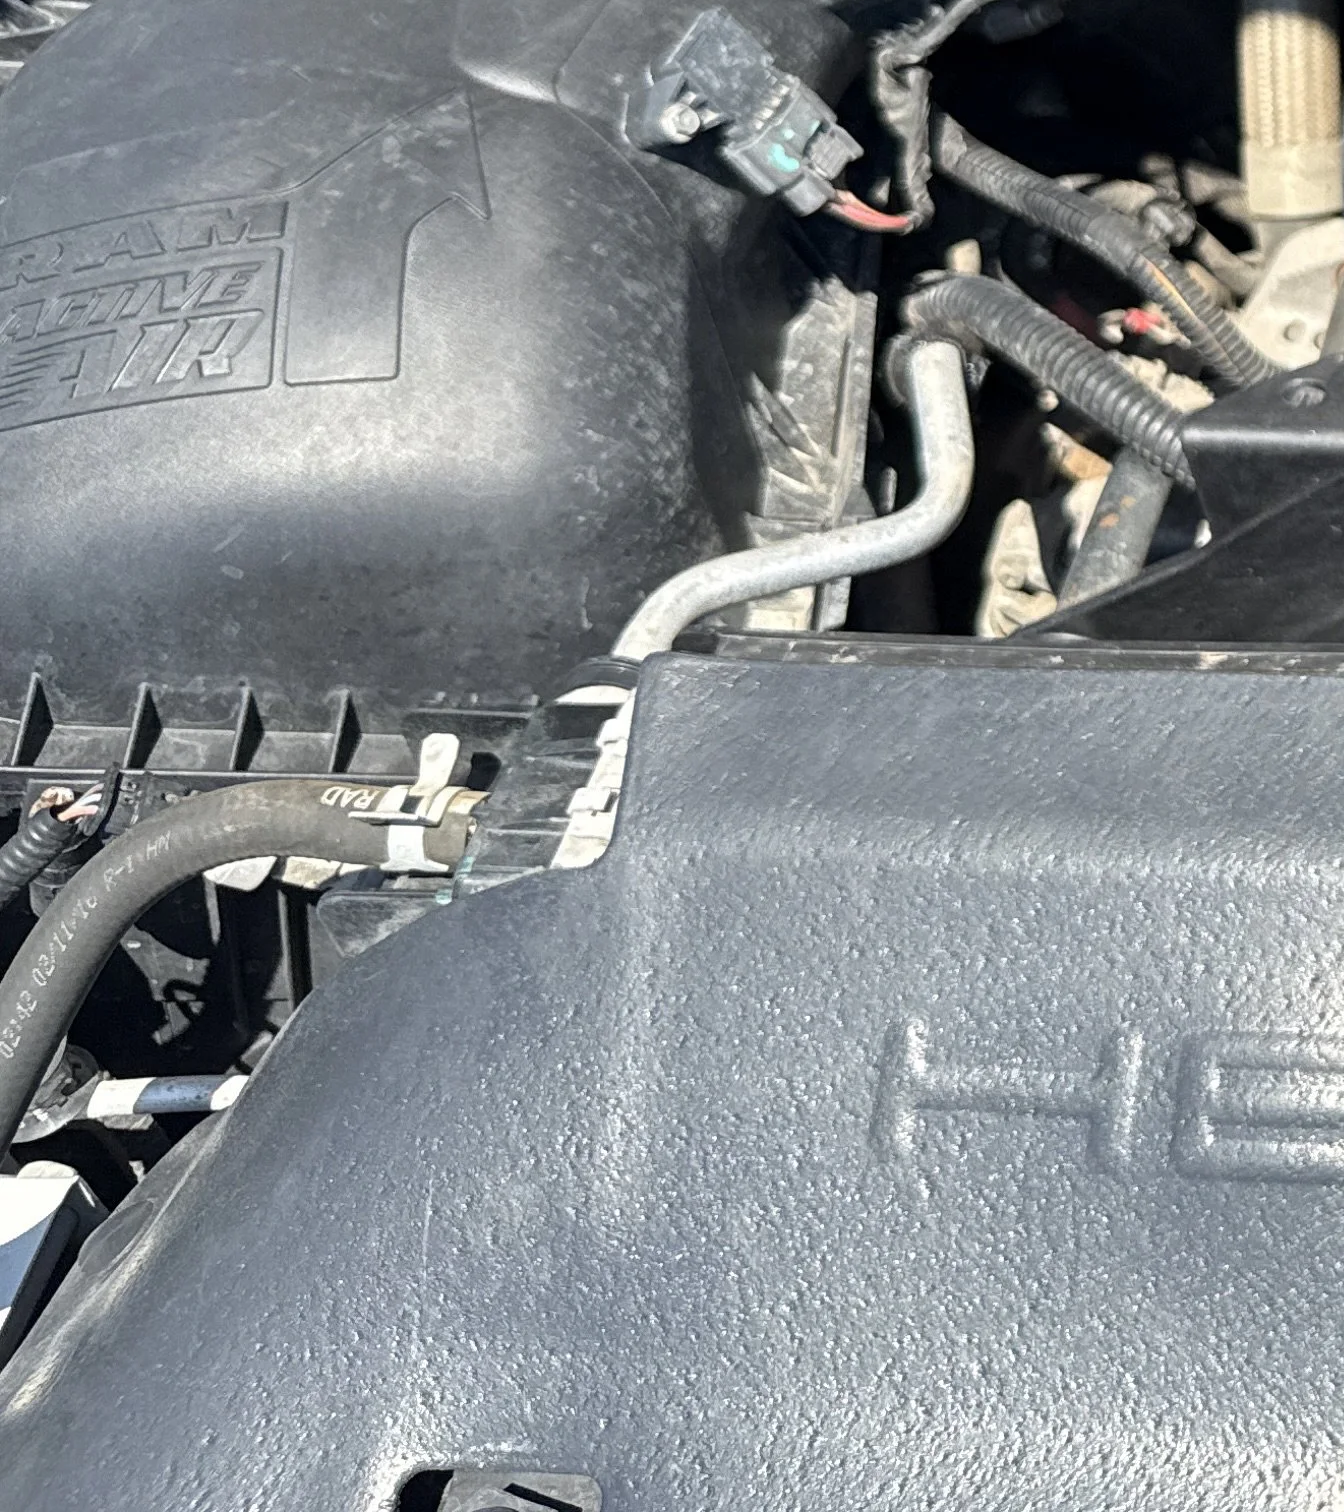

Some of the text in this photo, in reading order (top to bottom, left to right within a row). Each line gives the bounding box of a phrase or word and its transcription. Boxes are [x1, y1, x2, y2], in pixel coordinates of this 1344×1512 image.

[0, 260, 265, 343] ACTIVE
[8, 310, 265, 400] AIR
[319, 785, 380, 810] RAD
